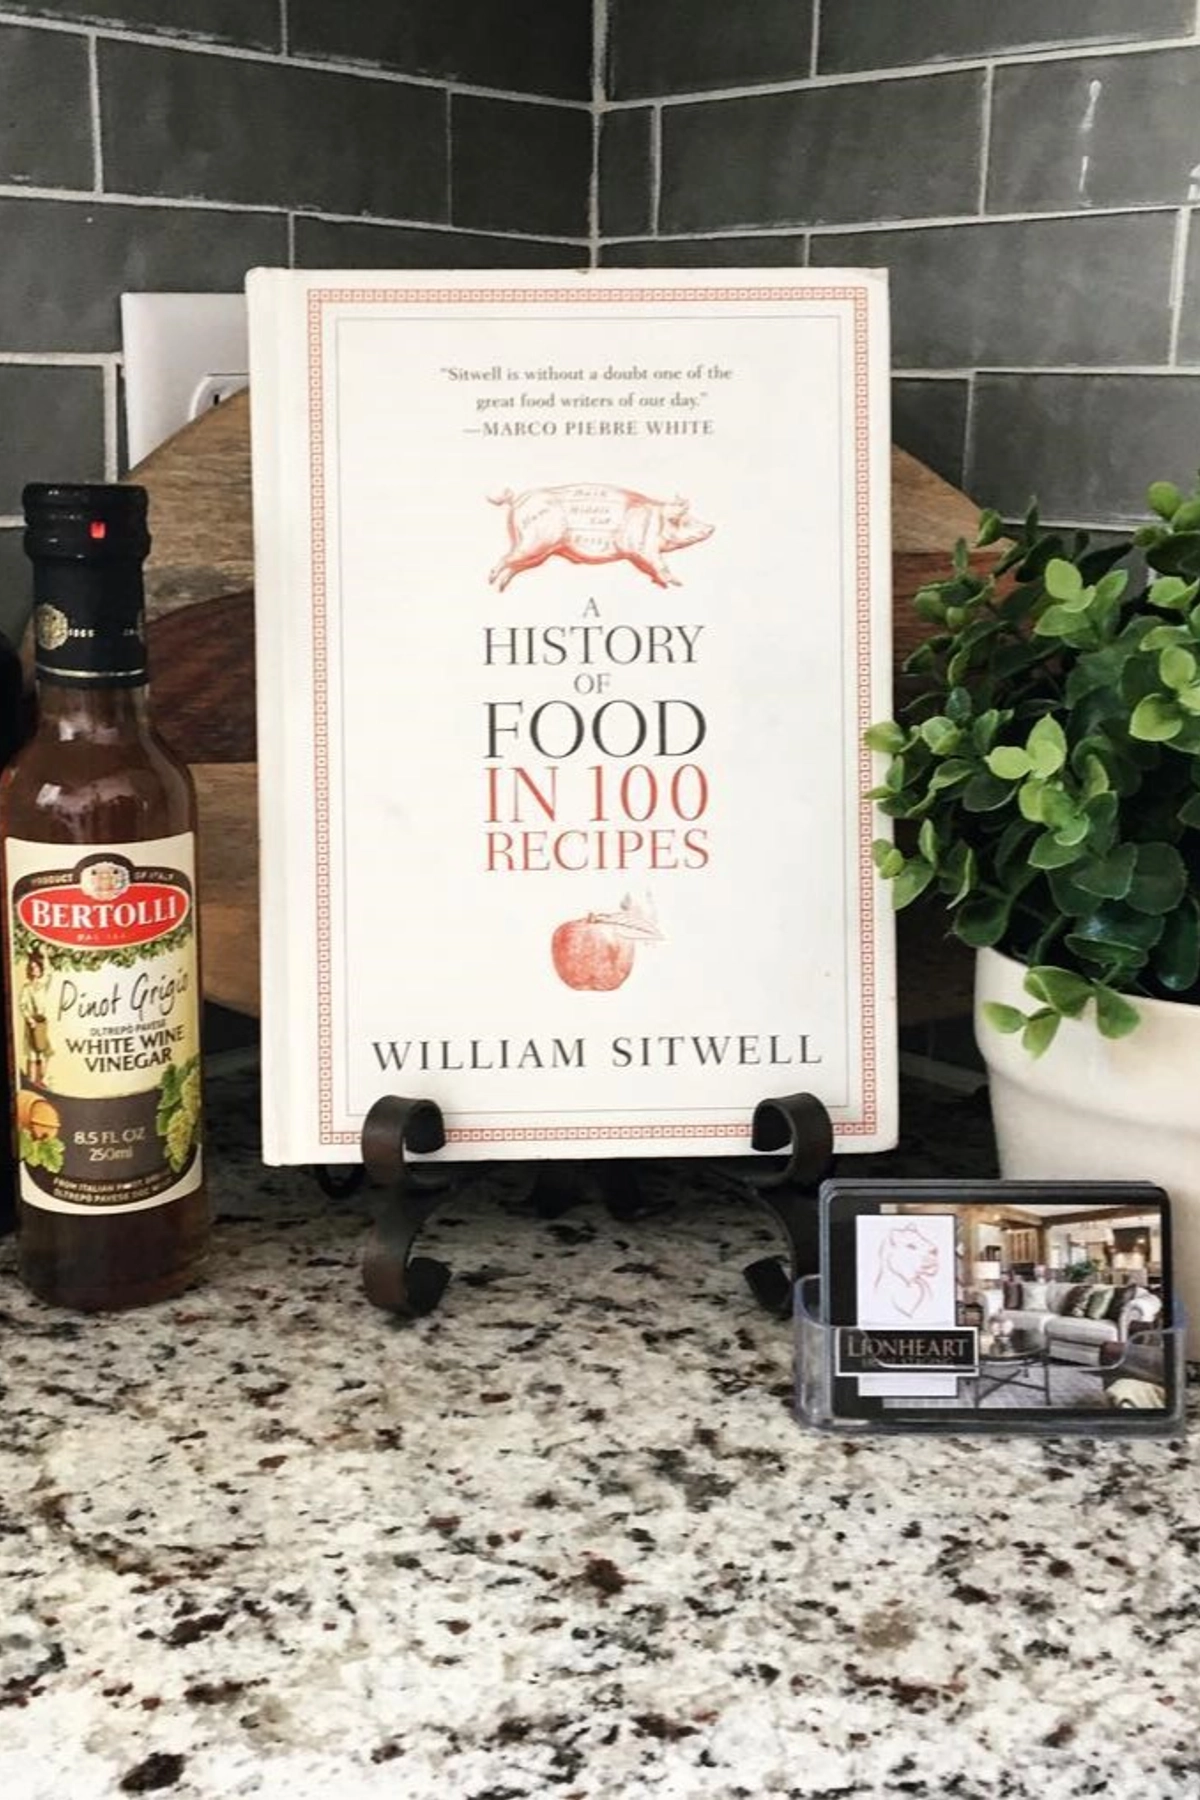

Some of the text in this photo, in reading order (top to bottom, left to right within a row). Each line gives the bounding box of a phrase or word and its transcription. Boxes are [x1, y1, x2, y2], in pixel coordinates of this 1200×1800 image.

[507, 367, 520, 380] is
[524, 365, 583, 380] without
[589, 370, 597, 380] a
[603, 364, 647, 380] doubt
[653, 369, 682, 380] one
[687, 363, 703, 380] of
[707, 364, 732, 380] the
[476, 396, 514, 412] great
[520, 392, 555, 408] food
[560, 394, 613, 408] writers
[618, 391, 635, 408] of
[639, 396, 665, 408] our
[565, 421, 638, 436] PIERRE
[646, 420, 715, 435] WHITE
[582, 596, 601, 618] A
[482, 625, 705, 666] HISTORY
[573, 672, 611, 694] OF
[483, 699, 707, 760] FOOD
[484, 763, 709, 823] IN 100
[486, 828, 710, 872] RECIPES
[31, 896, 178, 930] BERTOLLI
[57, 967, 190, 1022] Pinot Grigio
[65, 1024, 185, 1055] WHITE WINE
[371, 1034, 824, 1071] WILLIAM SITWELL
[84, 1047, 172, 1073] VINEGAR
[101, 1131, 120, 1144] FL
